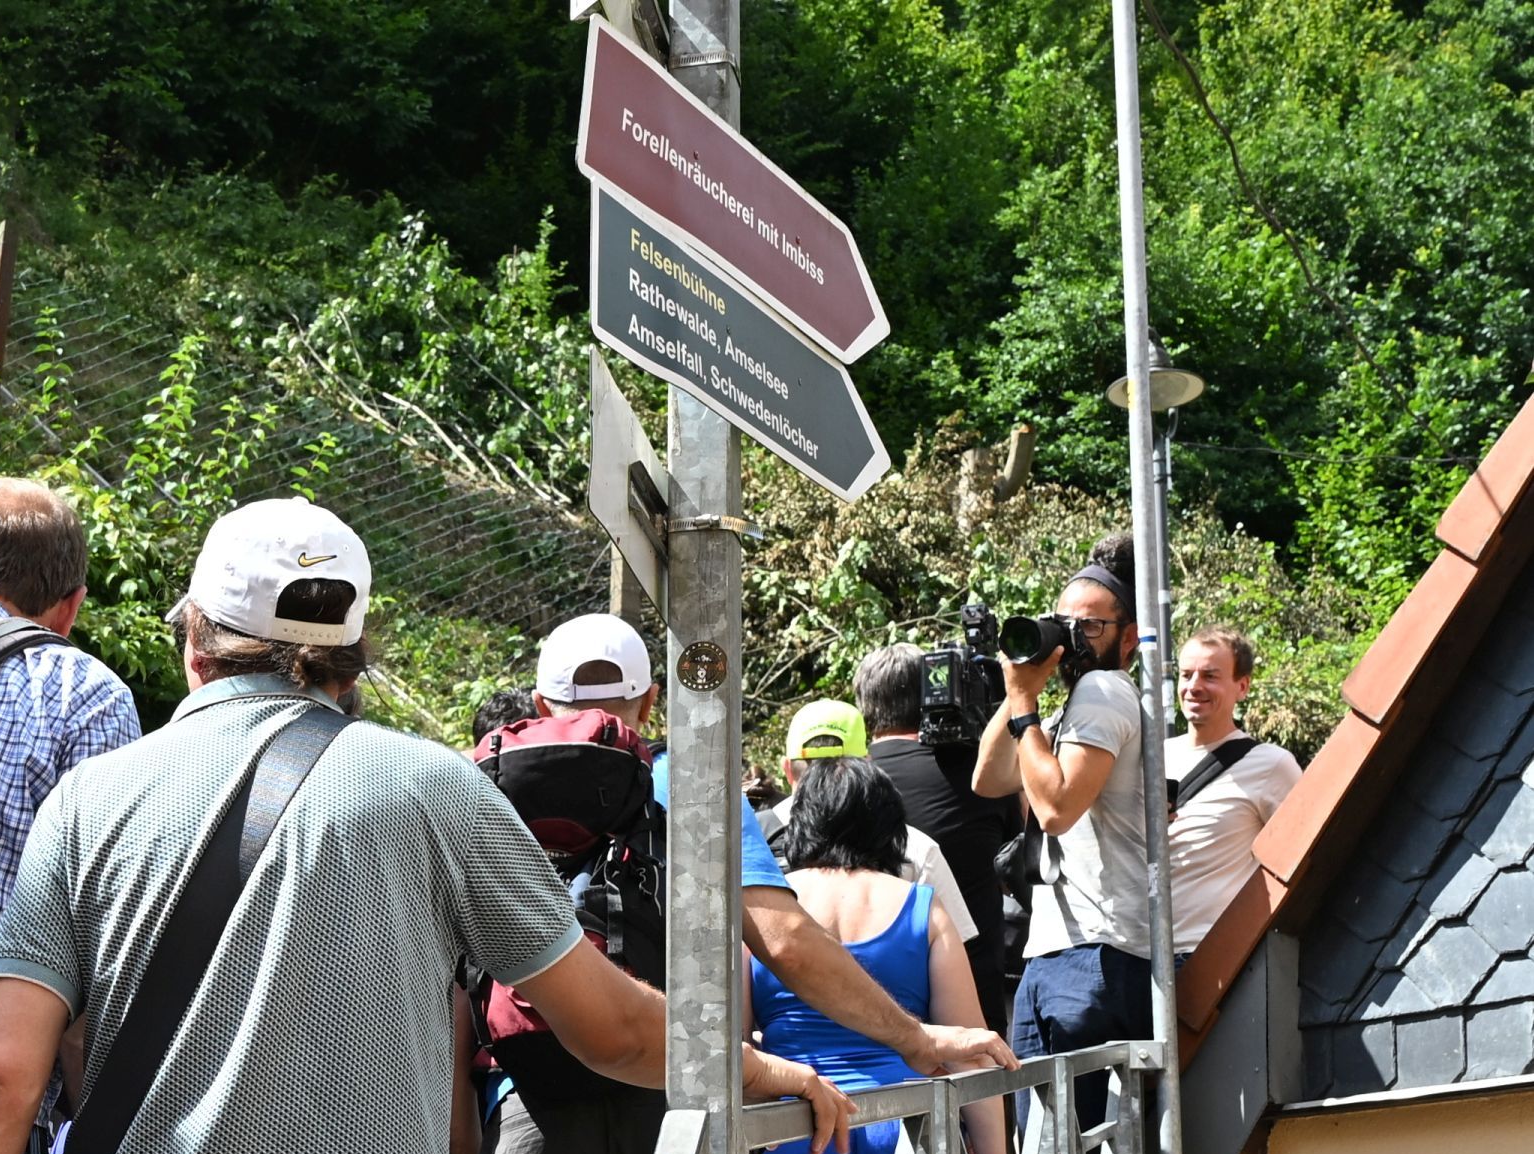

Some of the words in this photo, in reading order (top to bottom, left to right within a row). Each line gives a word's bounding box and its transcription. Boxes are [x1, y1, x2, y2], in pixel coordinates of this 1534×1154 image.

[622, 107, 754, 229] Forellenräucherei
[757, 218, 778, 249] mit
[782, 233, 824, 285] Imbiss
[629, 267, 721, 354] Rathewalde,
[724, 336, 789, 400] Amselsee
[631, 228, 726, 315] Felsenbühne
[628, 313, 707, 385] Amselfall,
[711, 365, 819, 460] Schwedenlöcher
